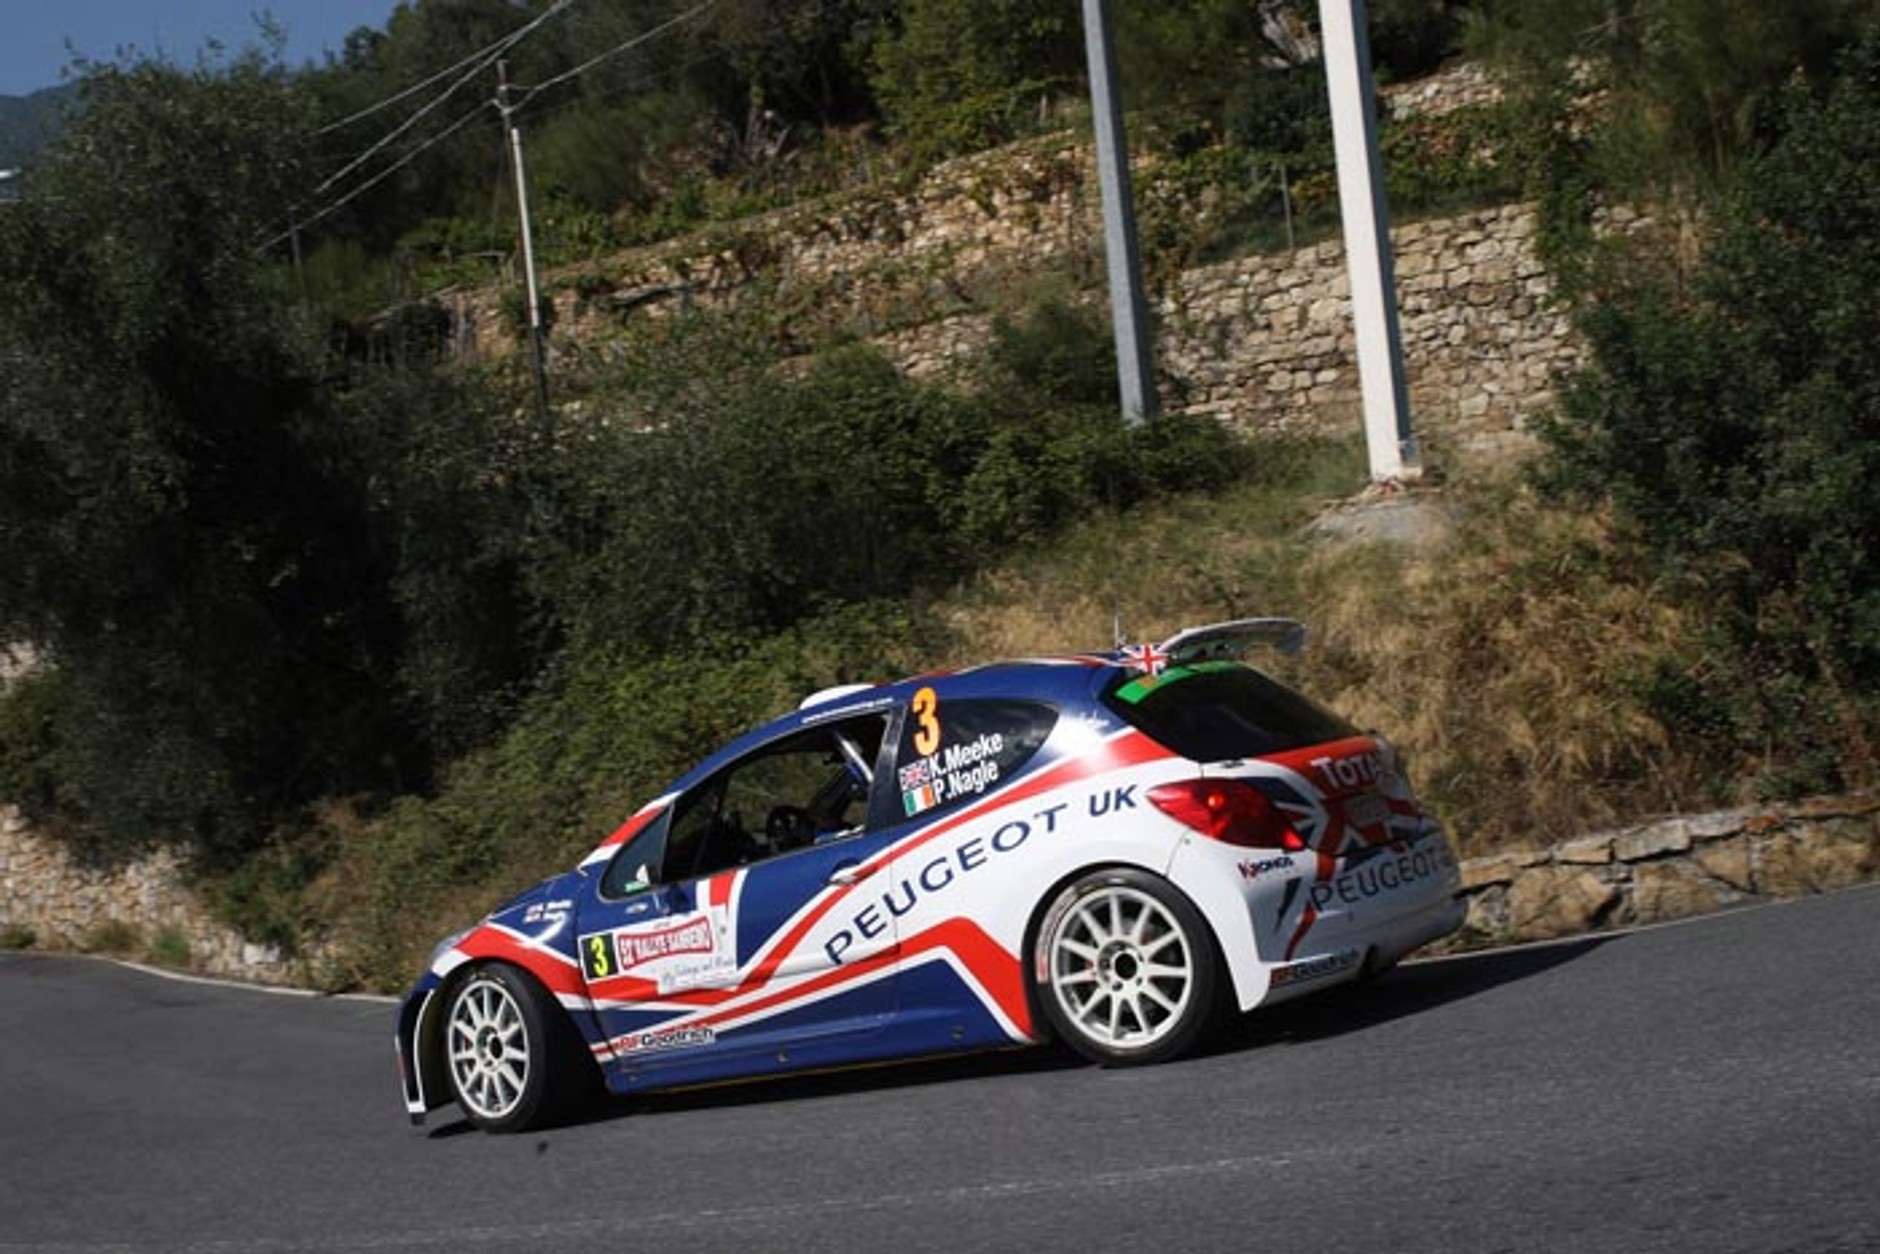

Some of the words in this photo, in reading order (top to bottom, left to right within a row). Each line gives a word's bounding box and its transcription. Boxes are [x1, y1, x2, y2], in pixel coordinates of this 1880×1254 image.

[913, 686, 940, 756] 3
[929, 732, 1003, 778] K.Meeke
[932, 760, 998, 804] P.Nagle
[824, 803, 1068, 965] PEUGEOT
[1089, 784, 1138, 817] UK
[589, 936, 609, 977] 3
